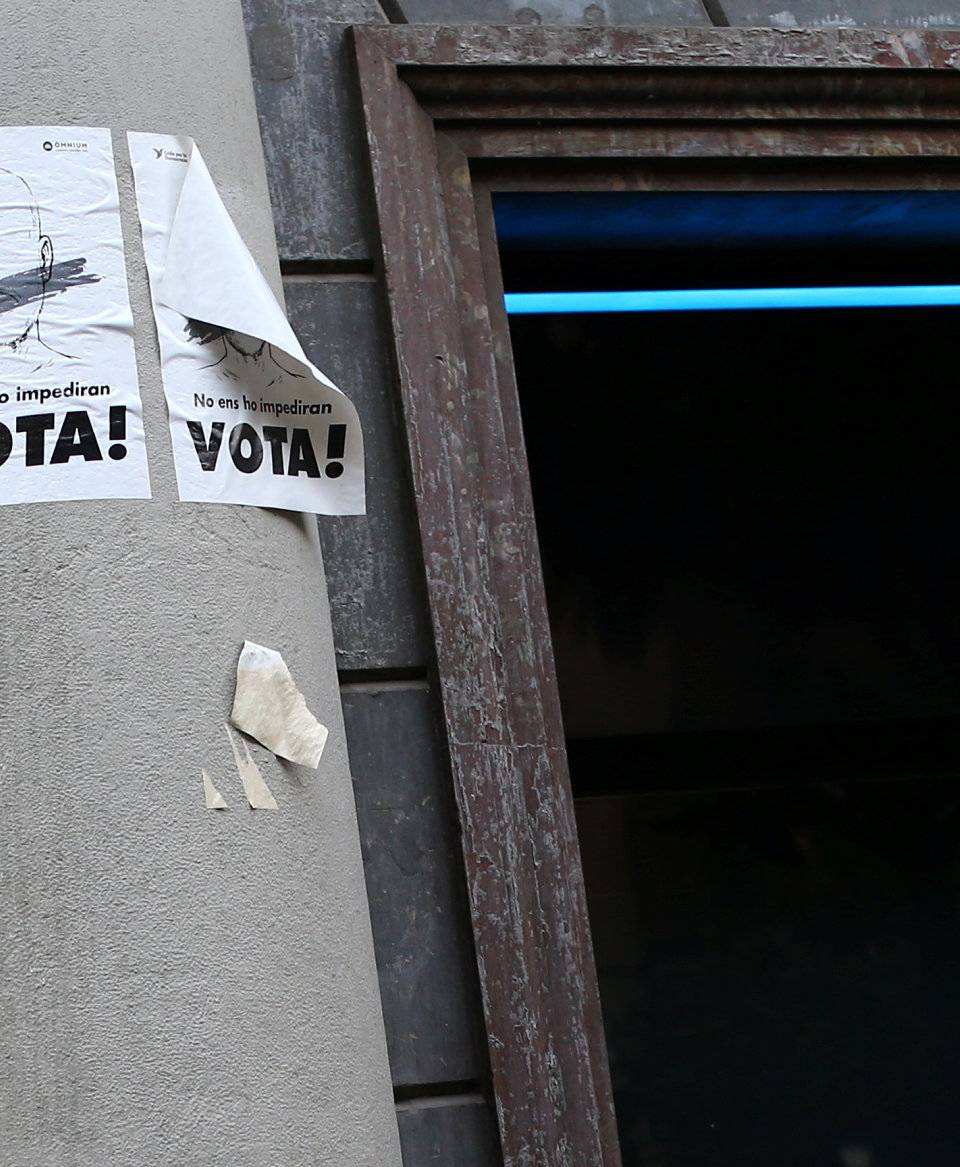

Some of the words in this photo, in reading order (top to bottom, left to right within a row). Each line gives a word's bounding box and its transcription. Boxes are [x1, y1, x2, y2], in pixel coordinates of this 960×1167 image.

[16, 382, 111, 404] impediran
[194, 393, 214, 408] No
[218, 397, 239, 410] ens
[243, 395, 257, 411] ho
[260, 398, 332, 417] impediran
[186, 420, 347, 479] VOTA!
